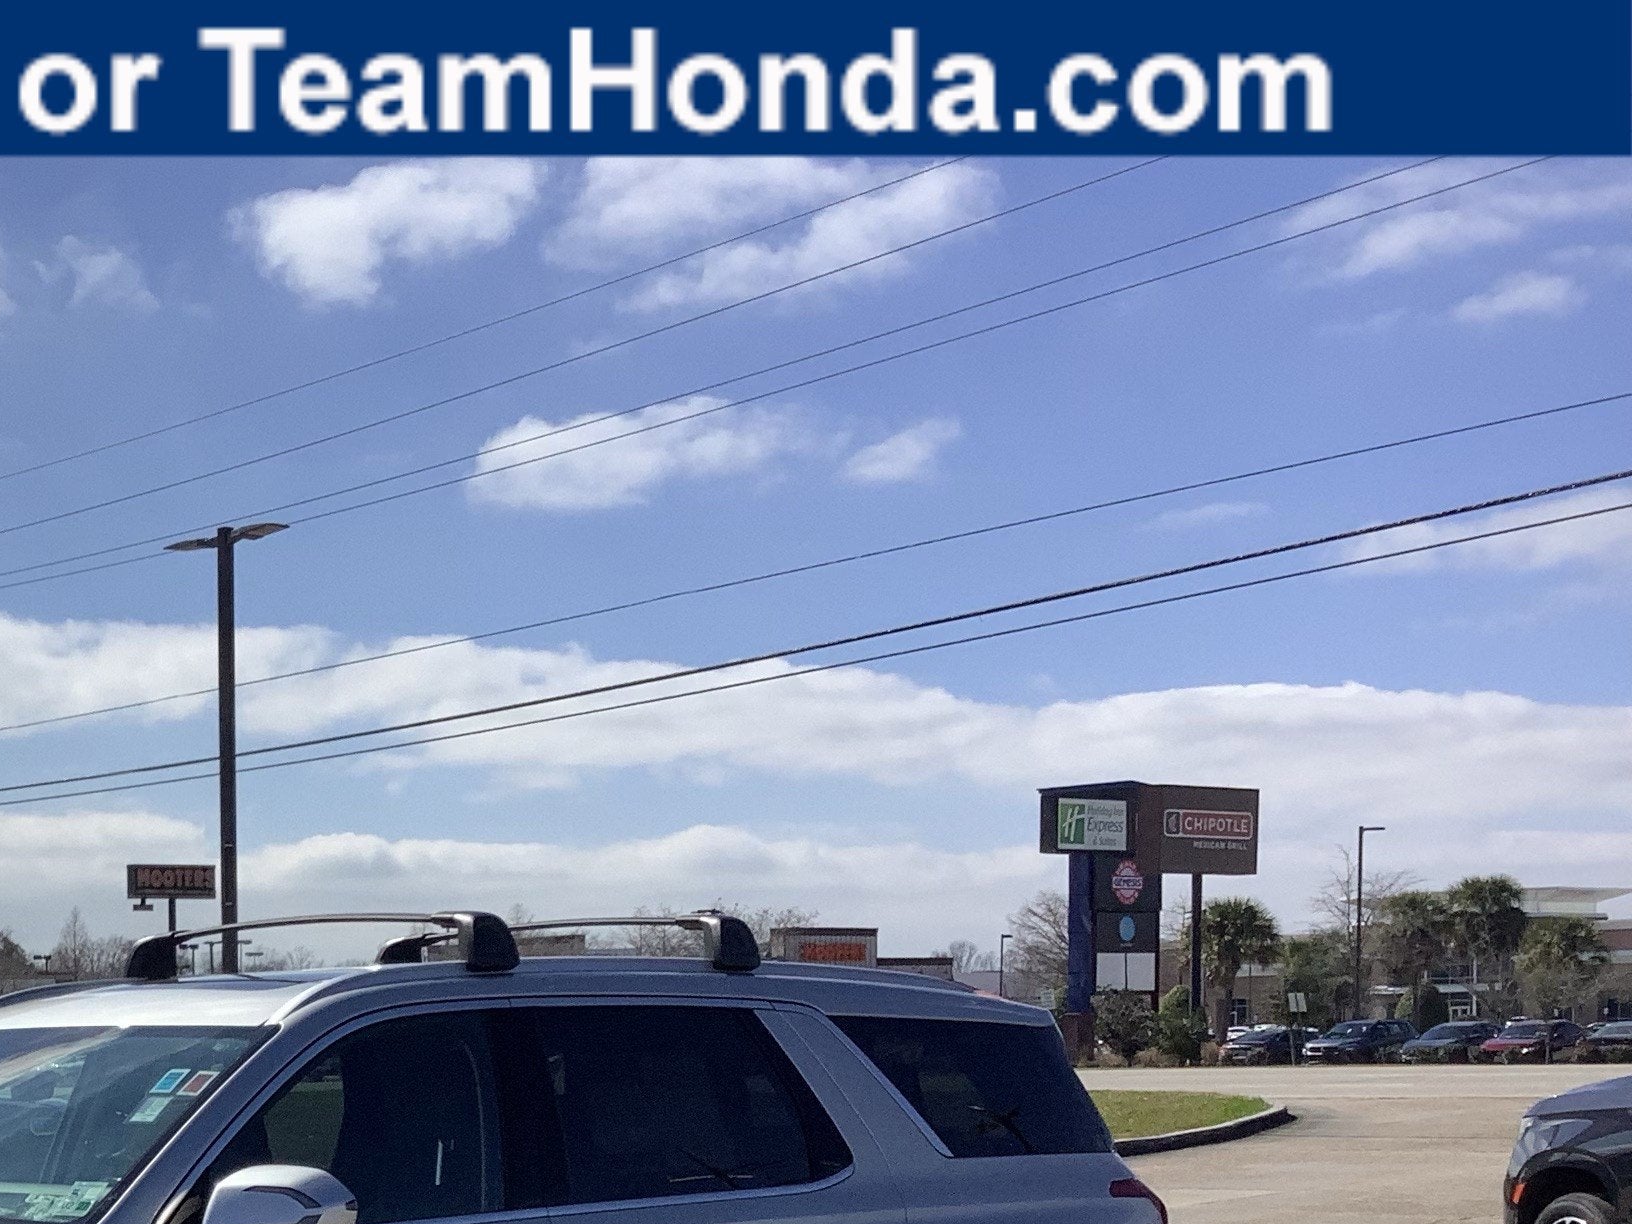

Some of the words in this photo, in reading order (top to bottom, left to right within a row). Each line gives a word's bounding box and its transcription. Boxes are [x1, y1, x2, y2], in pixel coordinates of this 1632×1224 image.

[1087, 816, 1124, 833] Express
[1183, 816, 1249, 833] CHIPOTLE
[136, 868, 215, 888] HOOTERS
